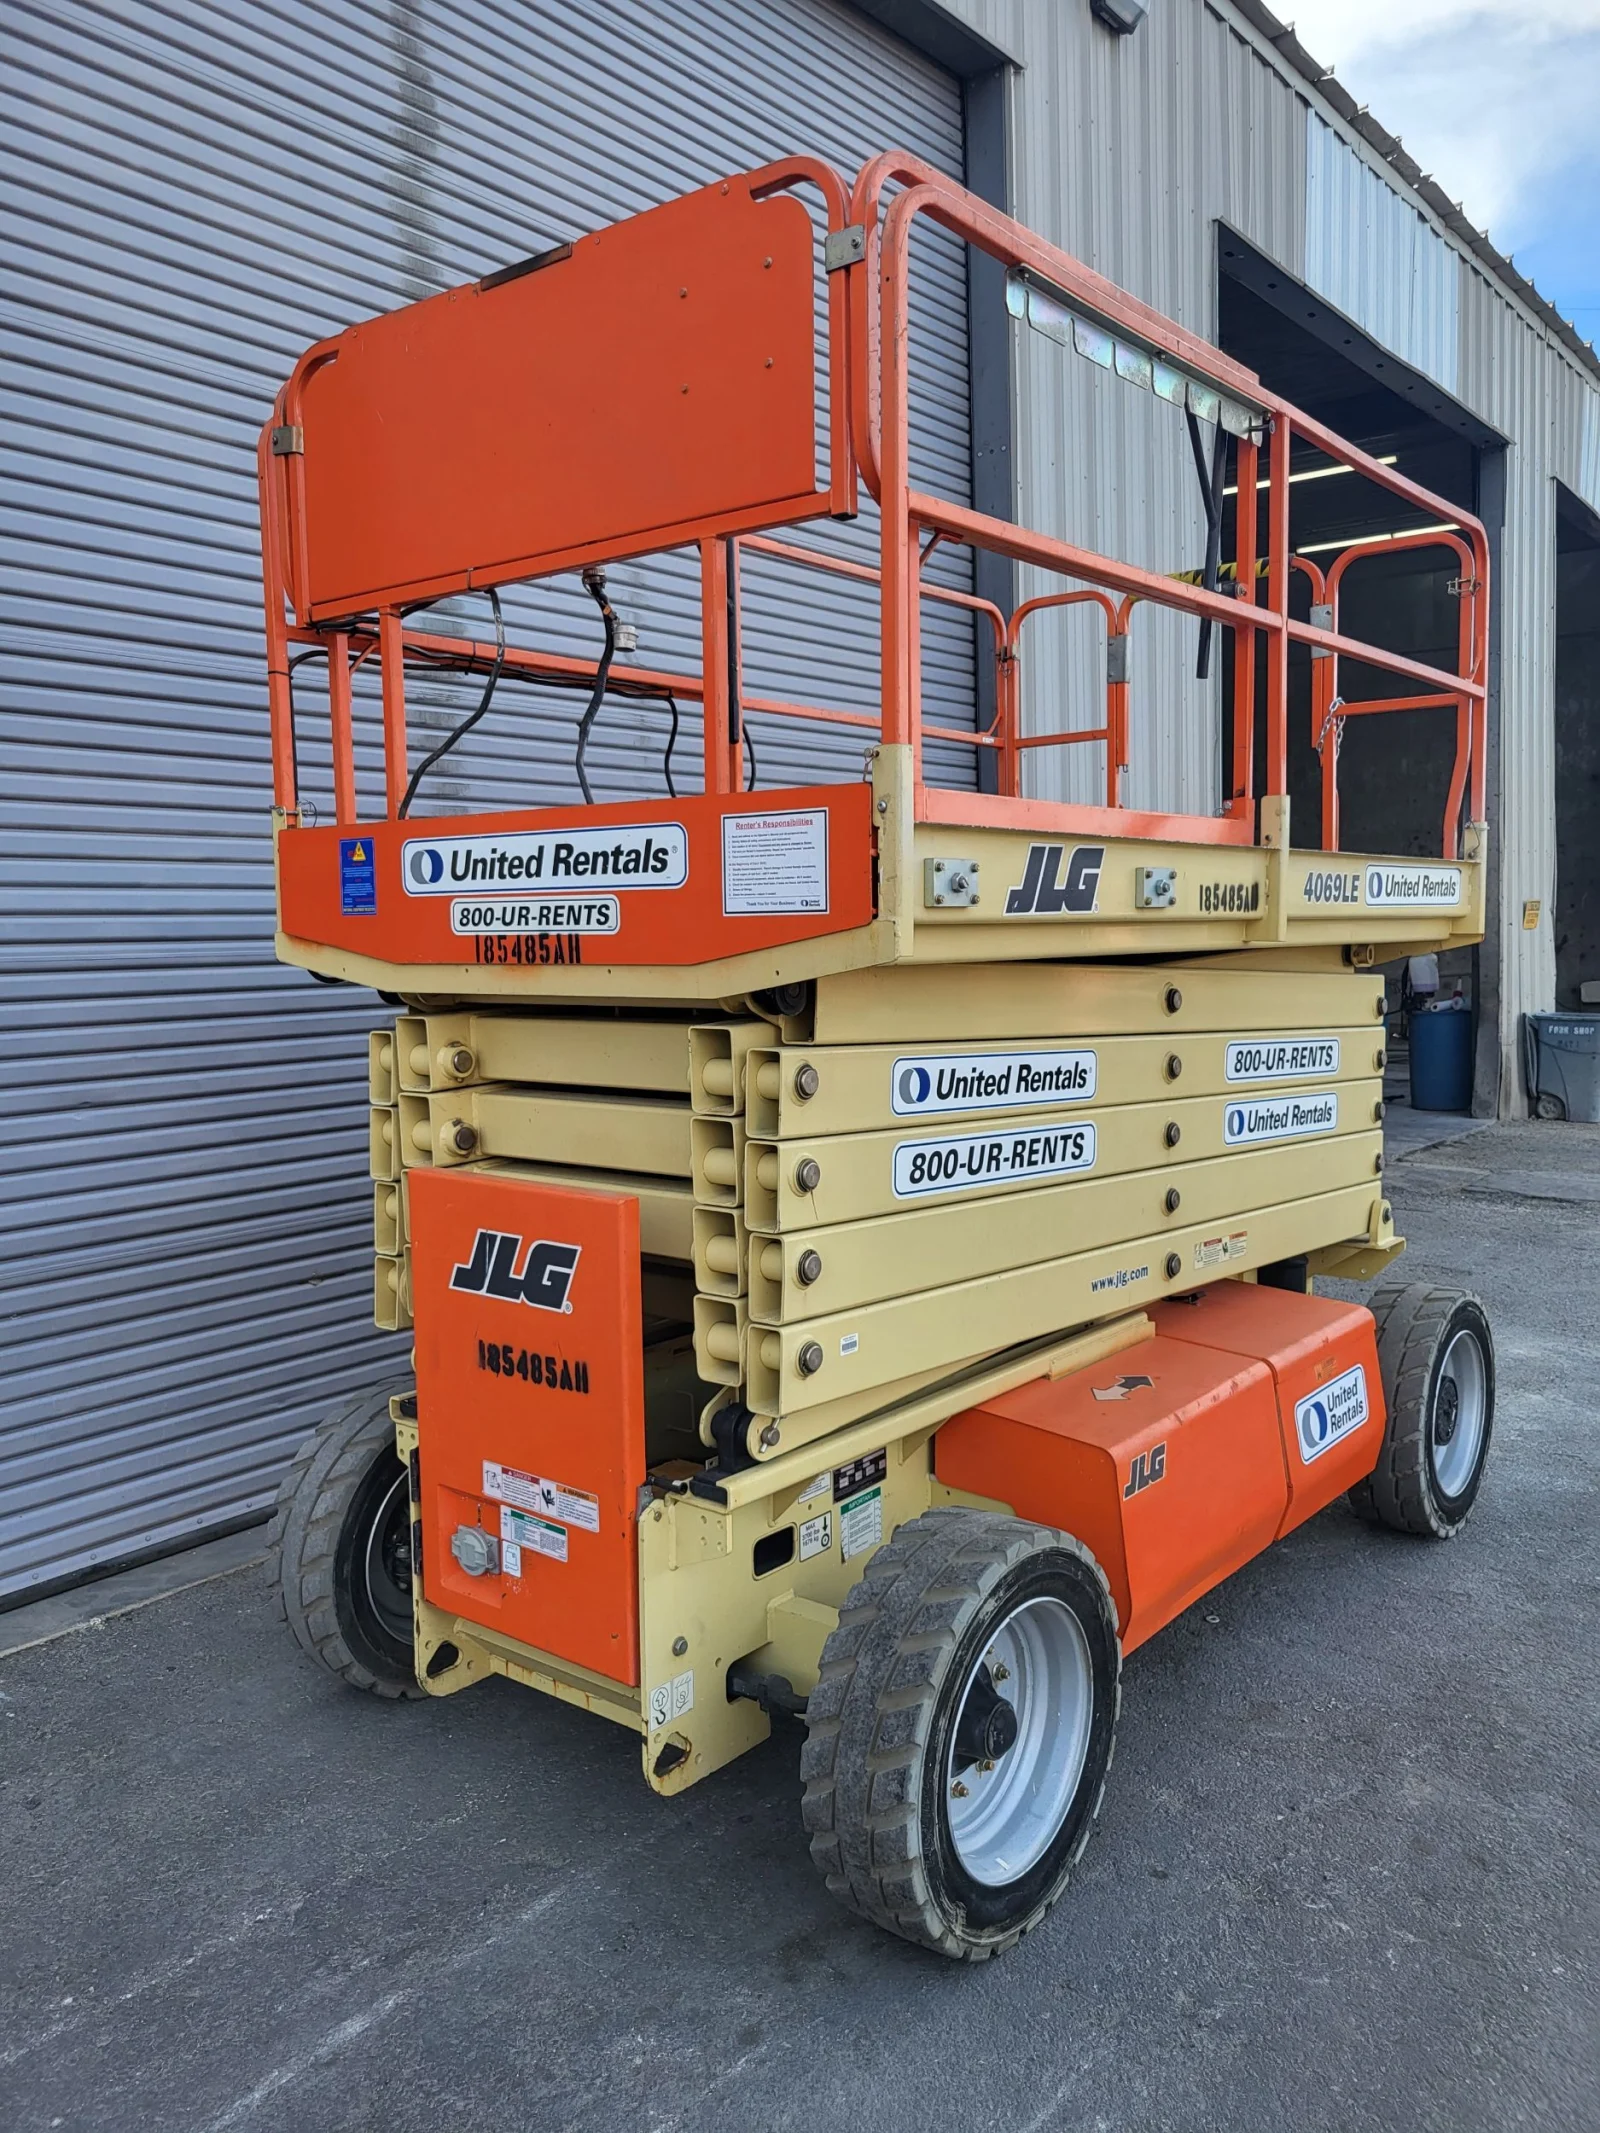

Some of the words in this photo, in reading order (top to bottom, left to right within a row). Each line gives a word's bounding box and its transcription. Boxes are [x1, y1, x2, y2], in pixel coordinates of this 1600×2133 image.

[735, 821, 761, 830] Renter's
[762, 818, 813, 829] Responsibilities
[450, 845, 545, 881] United
[552, 838, 669, 877] Rentals
[1004, 844, 1105, 915] JLG
[1304, 872, 1360, 903] 4069LE
[1385, 874, 1421, 898] United
[1421, 874, 1457, 898] Rentals
[459, 903, 611, 927] 800-UR-RENTS
[1573, 1026, 1595, 1035] SHOP
[1234, 1045, 1333, 1073] 800-UR-RENTS
[936, 1065, 1012, 1100] United
[1015, 1061, 1088, 1094] Rentals
[1247, 1106, 1289, 1133] United
[1291, 1101, 1333, 1127] Rentals
[909, 1132, 1085, 1184] 800-UR-RENTS
[449, 1228, 582, 1313] JLG
[1091, 1266, 1148, 1292] www.jlg.com
[1327, 1380, 1359, 1413] United
[1330, 1401, 1364, 1434] Rentals
[1123, 1441, 1167, 1501] JLG
[848, 1492, 874, 1509] IMPORTANT
[805, 1522, 816, 1531] MAX
